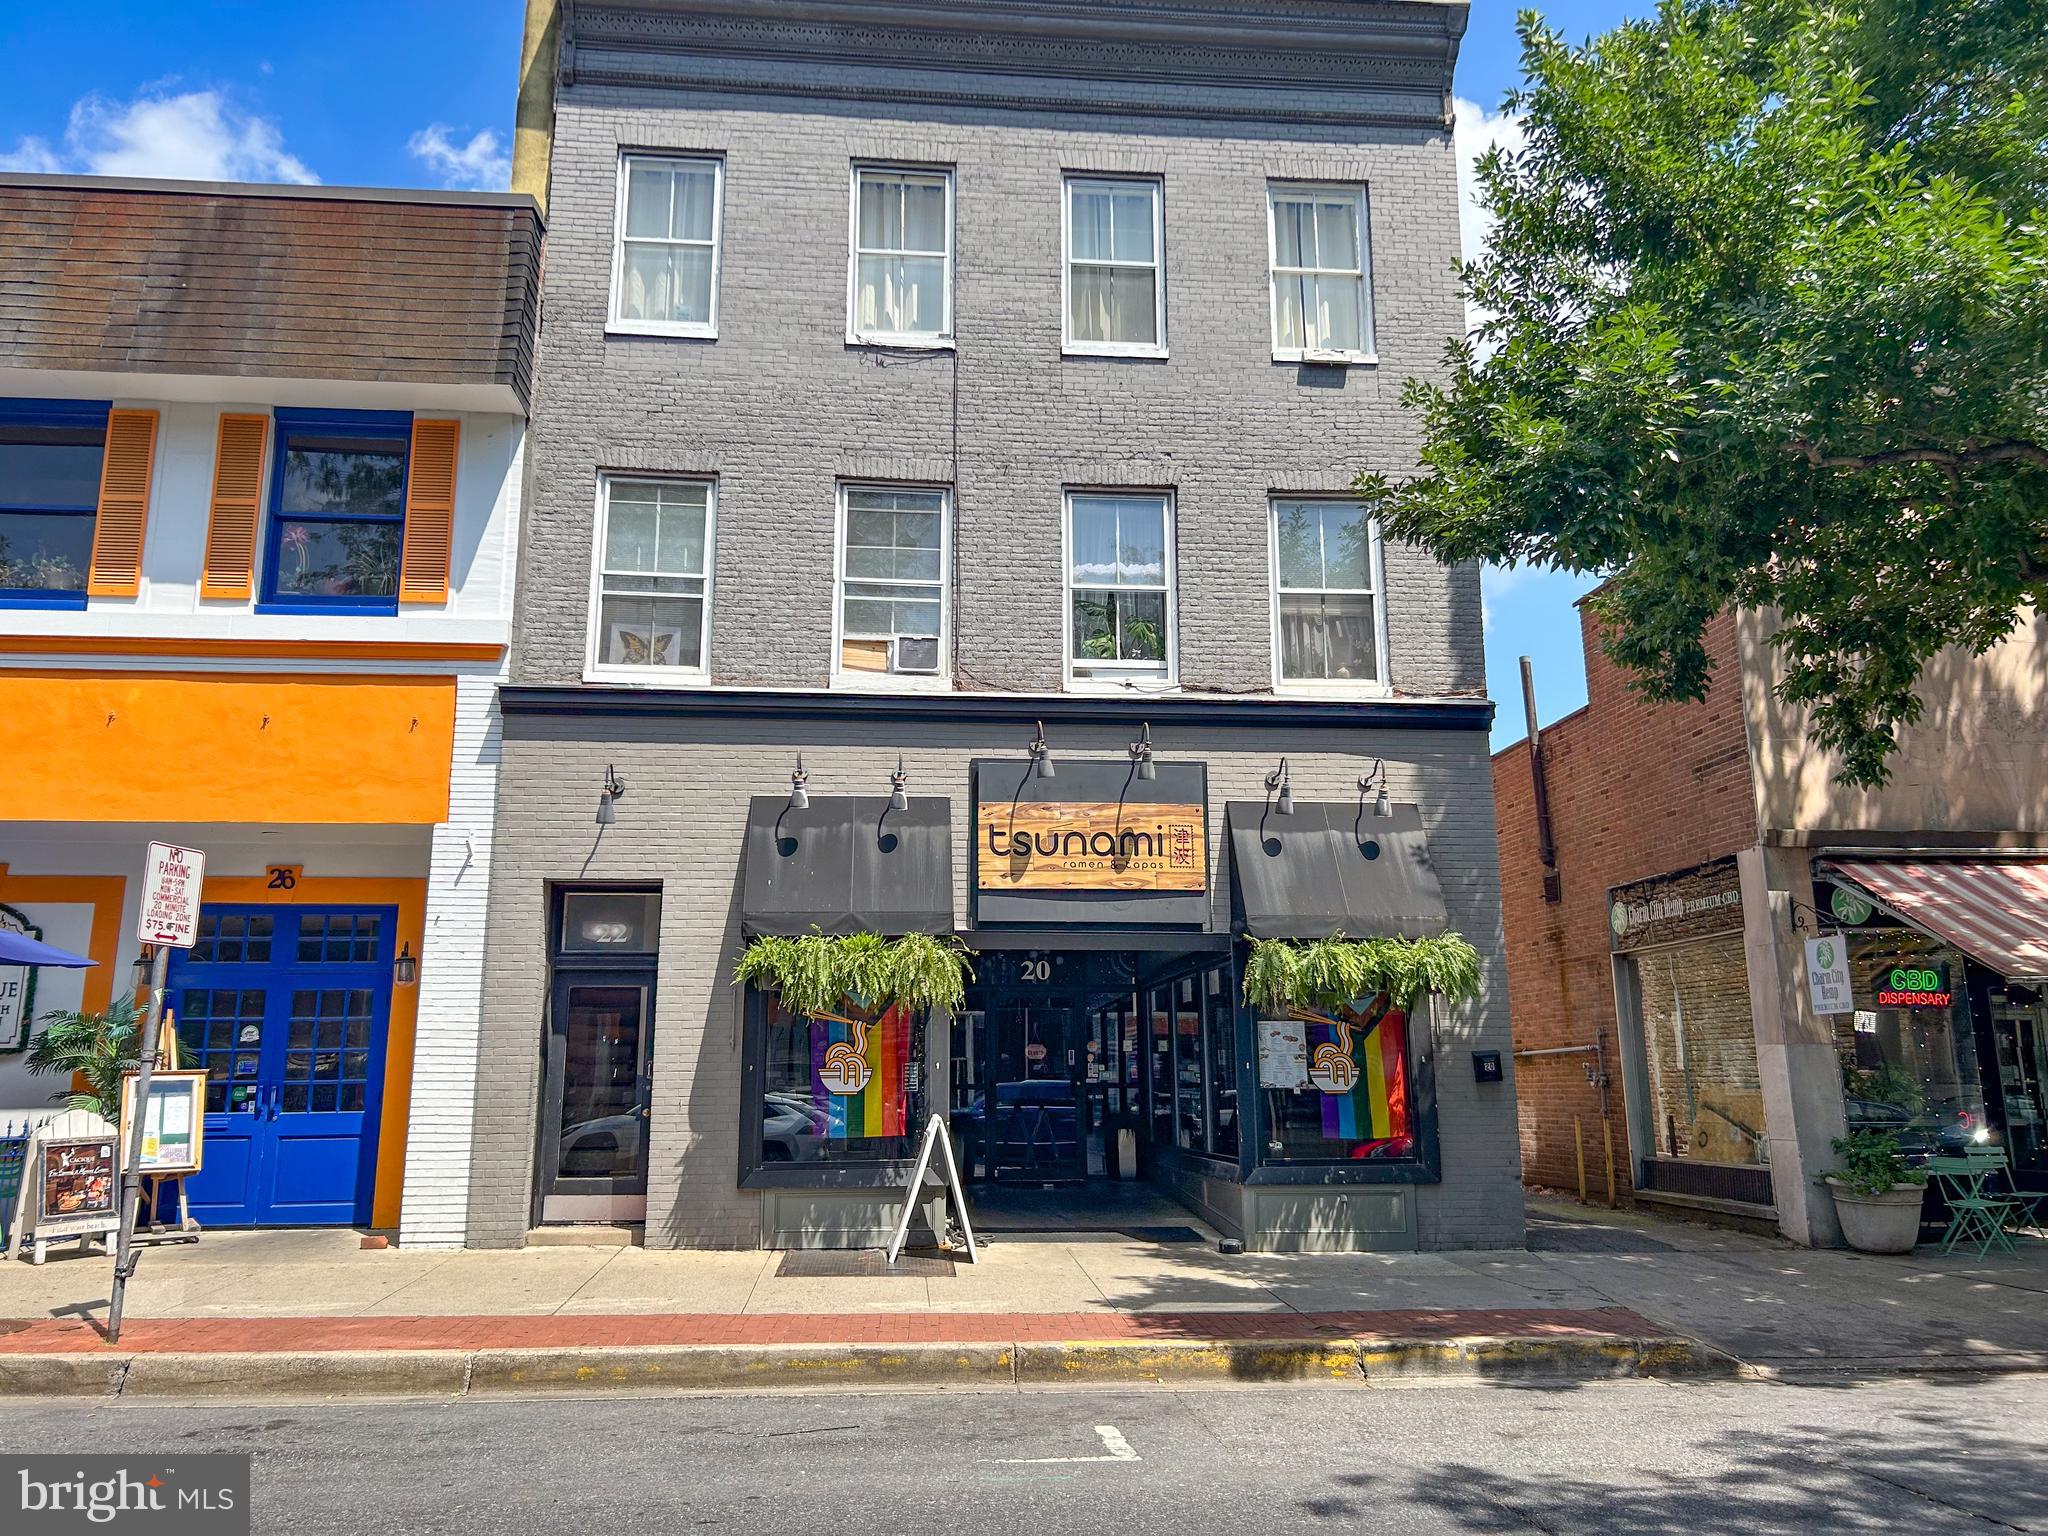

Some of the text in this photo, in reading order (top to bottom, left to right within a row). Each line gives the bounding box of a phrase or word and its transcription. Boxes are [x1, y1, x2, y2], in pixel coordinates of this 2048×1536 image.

[989, 823, 1163, 857] tsunami
[169, 848, 183, 863] NO
[159, 861, 191, 879] PARKING
[1063, 860, 1164, 871] ramen & tapas
[267, 868, 296, 890] 26
[152, 891, 189, 906] COMMERCIAL
[1685, 895, 1721, 912] PREMIUM
[1722, 890, 1739, 905] CBD
[153, 901, 186, 913] 20 MINUTE
[147, 908, 192, 923] LOADING ZONE
[170, 922, 190, 934] FINE
[596, 923, 628, 943] 22
[1020, 960, 1051, 980] 20
[1891, 969, 1938, 990] CBD
[1879, 992, 1950, 1005] DISPENSARY
